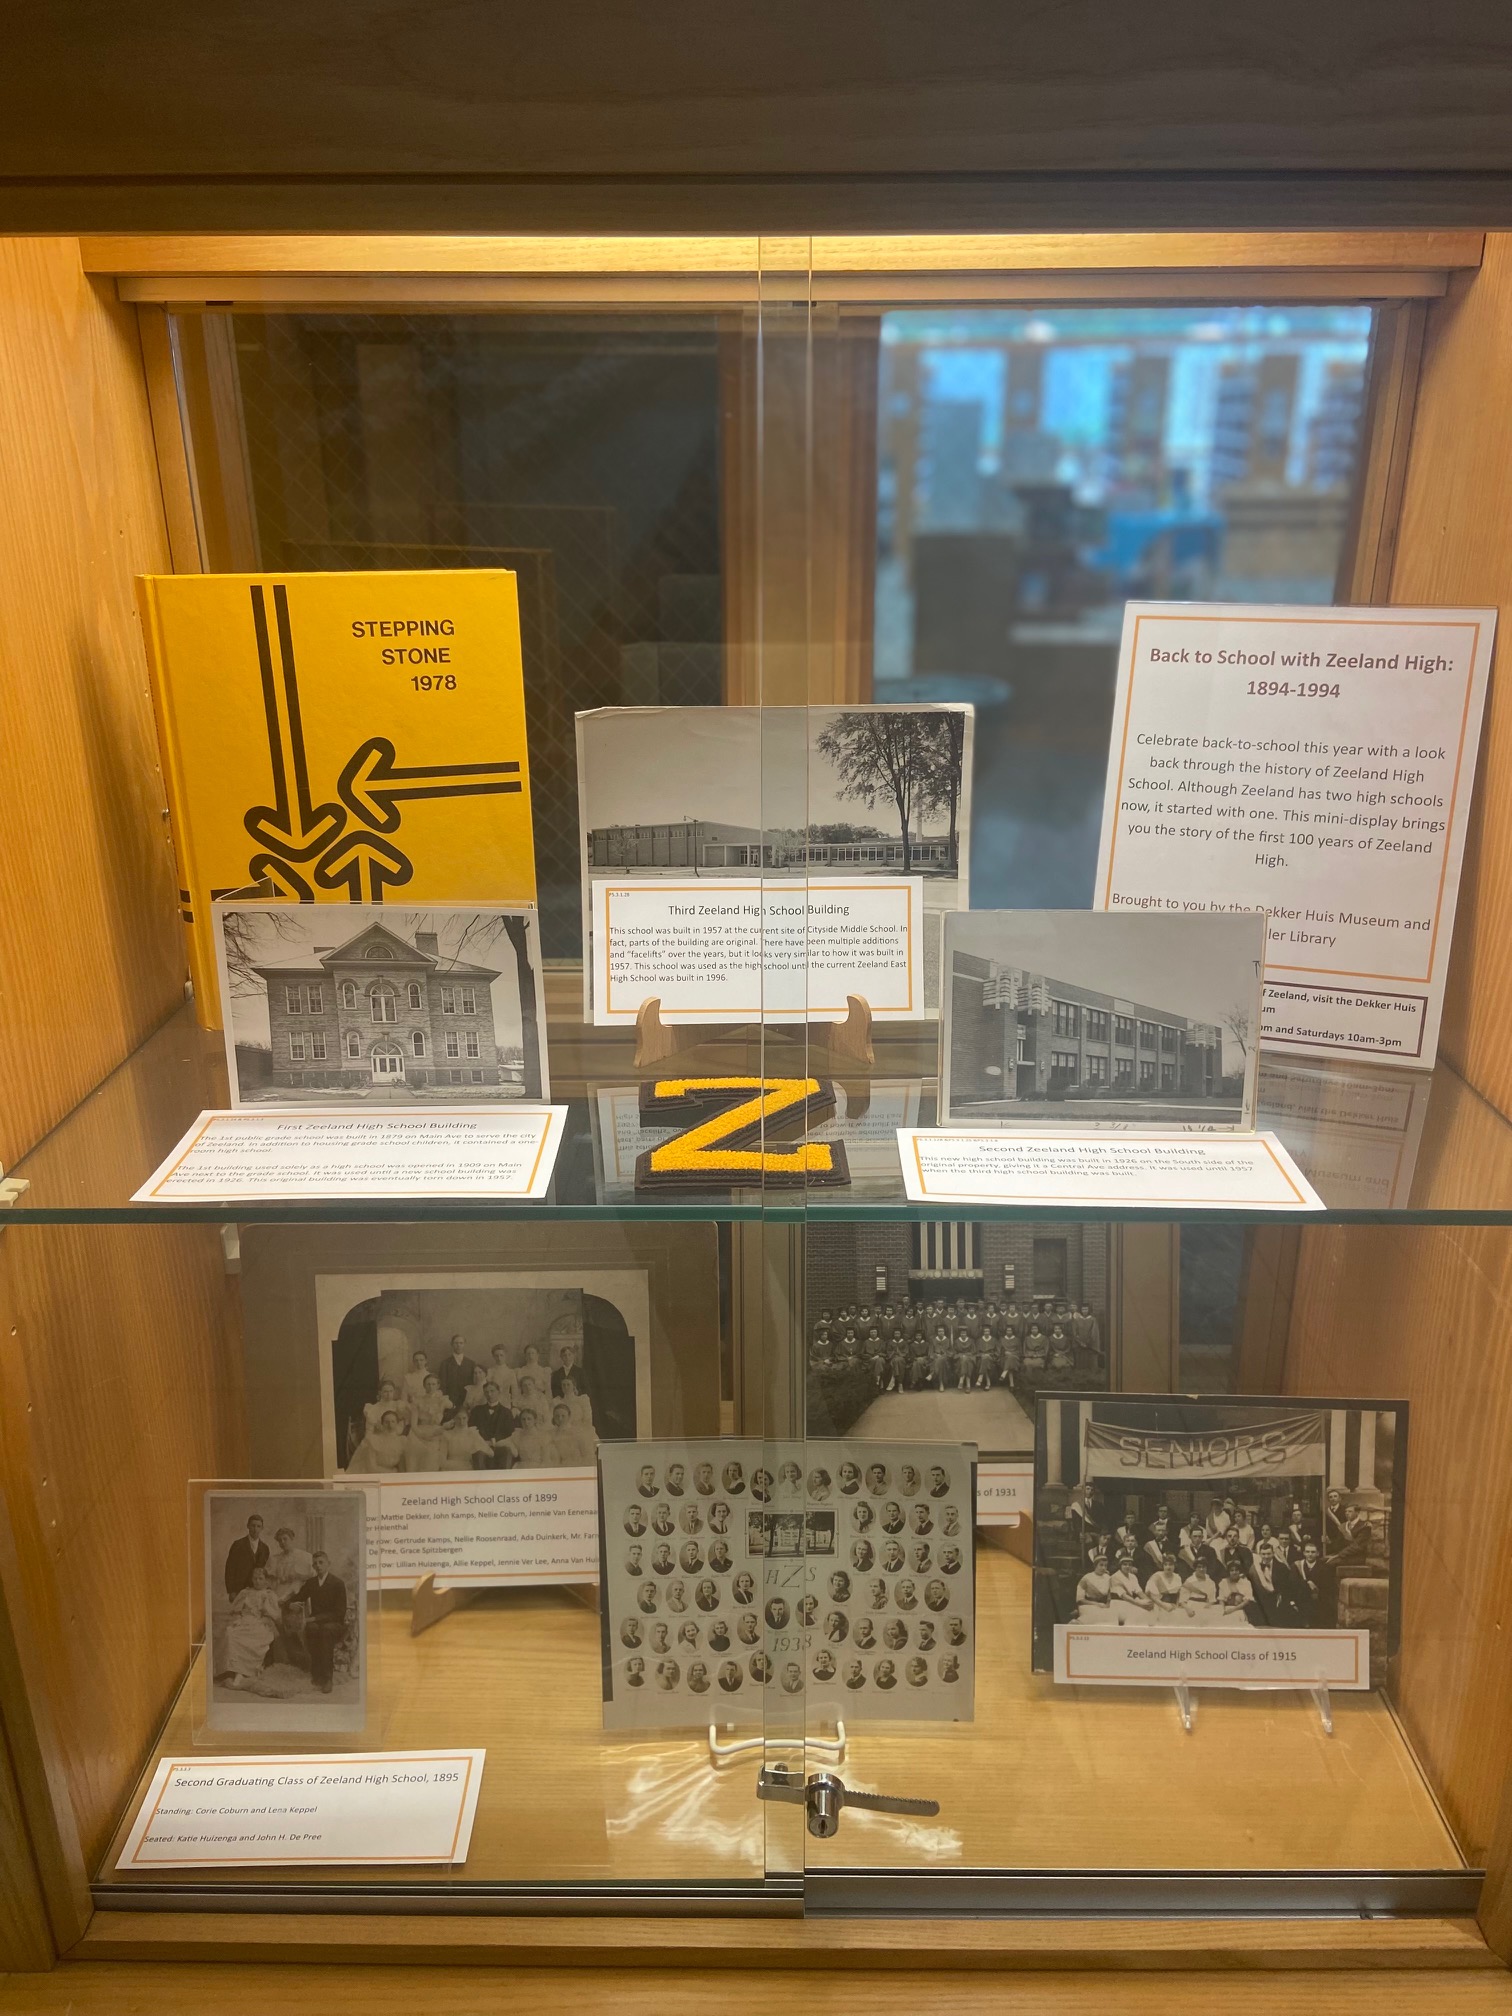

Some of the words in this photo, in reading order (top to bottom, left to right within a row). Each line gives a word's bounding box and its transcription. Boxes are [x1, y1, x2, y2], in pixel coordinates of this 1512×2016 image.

[351, 619, 454, 638] STEPPING
[382, 647, 451, 665] STONE
[1150, 648, 1190, 663] Back
[1194, 650, 1212, 664] to
[1217, 649, 1276, 666] School
[1280, 651, 1320, 667] with
[1325, 653, 1399, 670] Zeeland
[1404, 655, 1453, 674] High:
[411, 674, 457, 691] 1978
[1246, 680, 1340, 698] 1894-1994
[1136, 733, 1198, 747] Celebrate
[1202, 736, 1300, 752] back-to-school
[1304, 741, 1329, 754] this
[1332, 745, 1364, 757] year
[1367, 744, 1398, 757] with
[1402, 748, 1410, 758] a
[1415, 746, 1446, 760] look
[1150, 756, 1180, 769] back
[1183, 758, 1235, 774] through
[1239, 761, 1261, 773] the
[1264, 762, 1312, 779] history
[1315, 765, 1331, 777] of
[1332, 766, 1388, 780] Zeeland
[1392, 769, 1424, 784] High
[1128, 777, 1173, 791] School.
[1177, 780, 1237, 797] Although
[1241, 784, 1294, 798] Zeeland
[1298, 786, 1321, 800] has
[1326, 790, 1352, 802] two
[1356, 790, 1386, 806] high
[1390, 792, 1443, 807] schools
[1121, 801, 1150, 814] now,
[1154, 801, 1164, 813] it
[1166, 803, 1213, 816] started
[1216, 806, 1245, 818] with
[1249, 810, 1278, 820] one.
[1283, 809, 1310, 822] This
[1313, 812, 1398, 830] mini-display
[1402, 816, 1445, 833] brings
[1255, 853, 1288, 868] High.
[668, 905, 695, 915] Third
[698, 904, 740, 915] Zeeland
[769, 906, 804, 915] School
[808, 905, 850, 916] Building
[1112, 894, 1162, 908] Brought
[1166, 898, 1179, 908] to
[1183, 902, 1206, 912] you
[1305, 910, 1334, 923] Huis
[1338, 912, 1399, 928] Museum
[1404, 919, 1431, 931] and
[627, 926, 653, 935] school
[672, 926, 691, 934] built
[703, 926, 722, 934] 1957
[796, 926, 805, 934] of
[840, 925, 868, 933] Middle
[870, 924, 898, 933] School.
[1290, 930, 1336, 948] Library
[1268, 989, 1310, 1003] Zeeland,
[1312, 994, 1333, 1004] visit
[1336, 996, 1352, 1006] the
[1355, 998, 1392, 1010] Dekker
[1393, 1002, 1416, 1013] Huis
[1275, 1026, 1294, 1034] and
[1296, 1027, 1345, 1041] Saturdays
[1347, 1033, 1402, 1047] 10am-3pm
[650, 1077, 832, 1172] Z
[1119, 1431, 1287, 1469] SENIORS
[401, 1496, 438, 1506] Zeeland
[440, 1496, 462, 1506] High
[464, 1495, 494, 1504] School
[496, 1494, 520, 1504] Class
[522, 1494, 532, 1503] of
[535, 1493, 558, 1502] 1899
[984, 1488, 993, 1496] of
[996, 1488, 1016, 1496] 1931
[772, 1634, 812, 1652] 1938
[1126, 1649, 1167, 1659] Zeeland
[1169, 1650, 1192, 1661] High
[1194, 1650, 1228, 1660] School
[1230, 1650, 1256, 1660] Class
[1258, 1651, 1269, 1661] of
[1272, 1651, 1297, 1661] 1915
[174, 1777, 215, 1787] Second
[216, 1777, 275, 1787] Graduating
[277, 1776, 304, 1785] Class
[306, 1775, 319, 1785] of
[319, 1775, 363, 1784] Zeeland
[364, 1774, 389, 1785] High
[391, 1773, 429, 1784] School,
[433, 1773, 459, 1782] 1895
[156, 1807, 194, 1816] Standing:
[289, 1806, 318, 1814] Keppel
